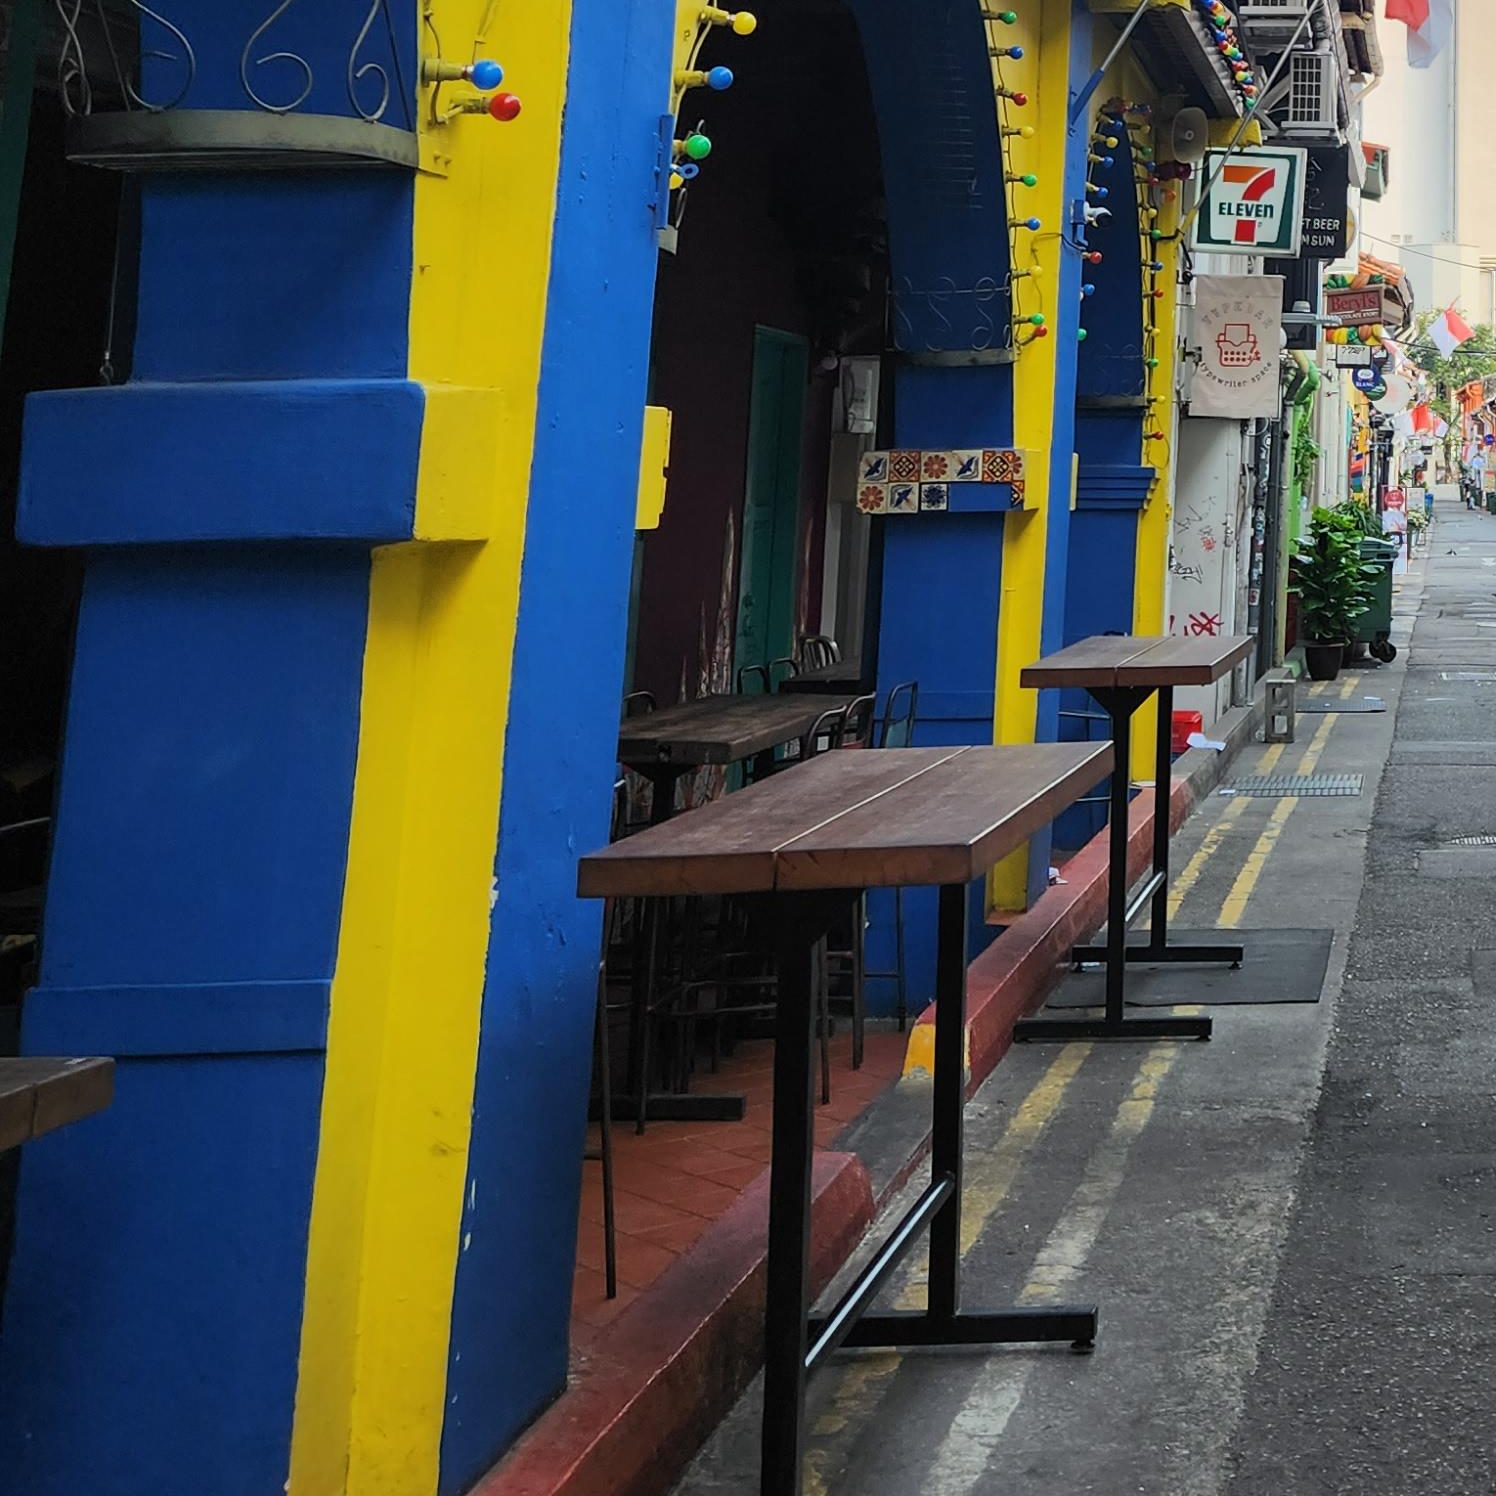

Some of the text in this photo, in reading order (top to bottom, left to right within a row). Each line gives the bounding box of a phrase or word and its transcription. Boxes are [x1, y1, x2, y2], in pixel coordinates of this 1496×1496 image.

[1223, 164, 1276, 243] 7
[1313, 218, 1340, 231] BEER
[1332, 293, 1377, 312] Beryl's
[1199, 361, 1273, 388] typewriter space
